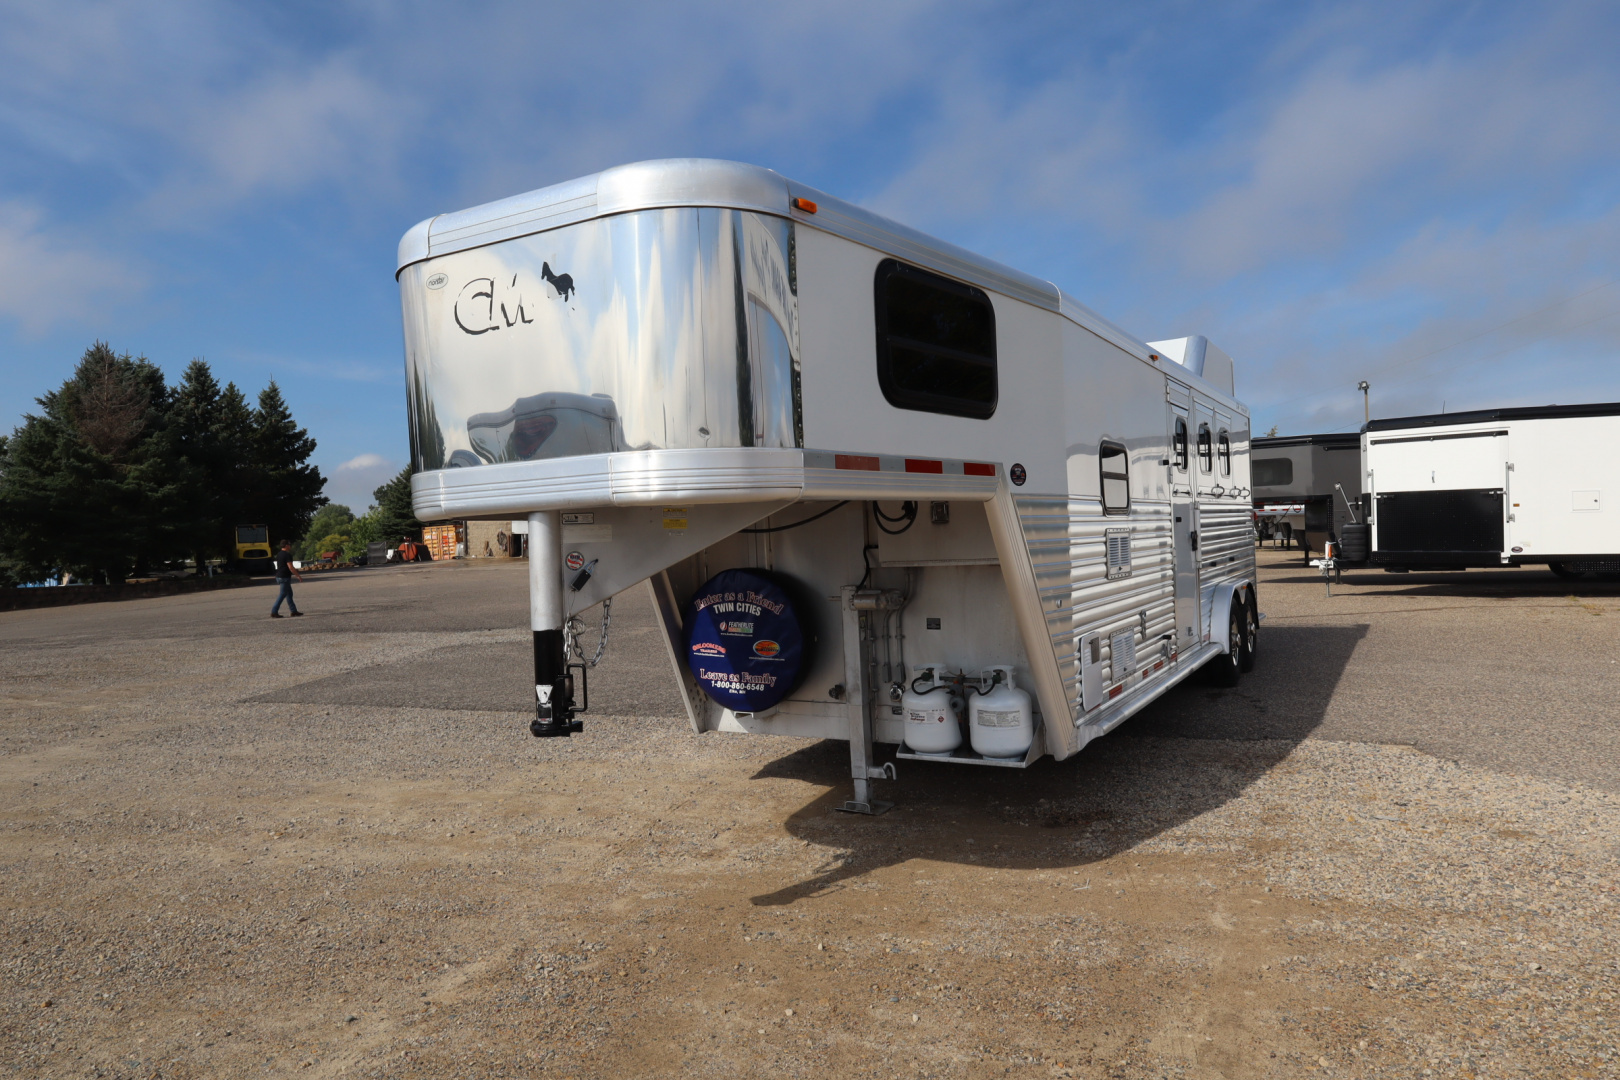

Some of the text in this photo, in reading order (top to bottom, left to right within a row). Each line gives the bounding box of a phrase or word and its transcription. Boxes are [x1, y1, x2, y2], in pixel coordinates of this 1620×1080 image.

[694, 591, 784, 615] Enter as a Friend
[713, 602, 762, 616] TWIN CITIES
[728, 621, 754, 629] FEATHERLITE
[700, 668, 777, 687] Leave as Family
[711, 681, 765, 691] 1-800-860-6548
